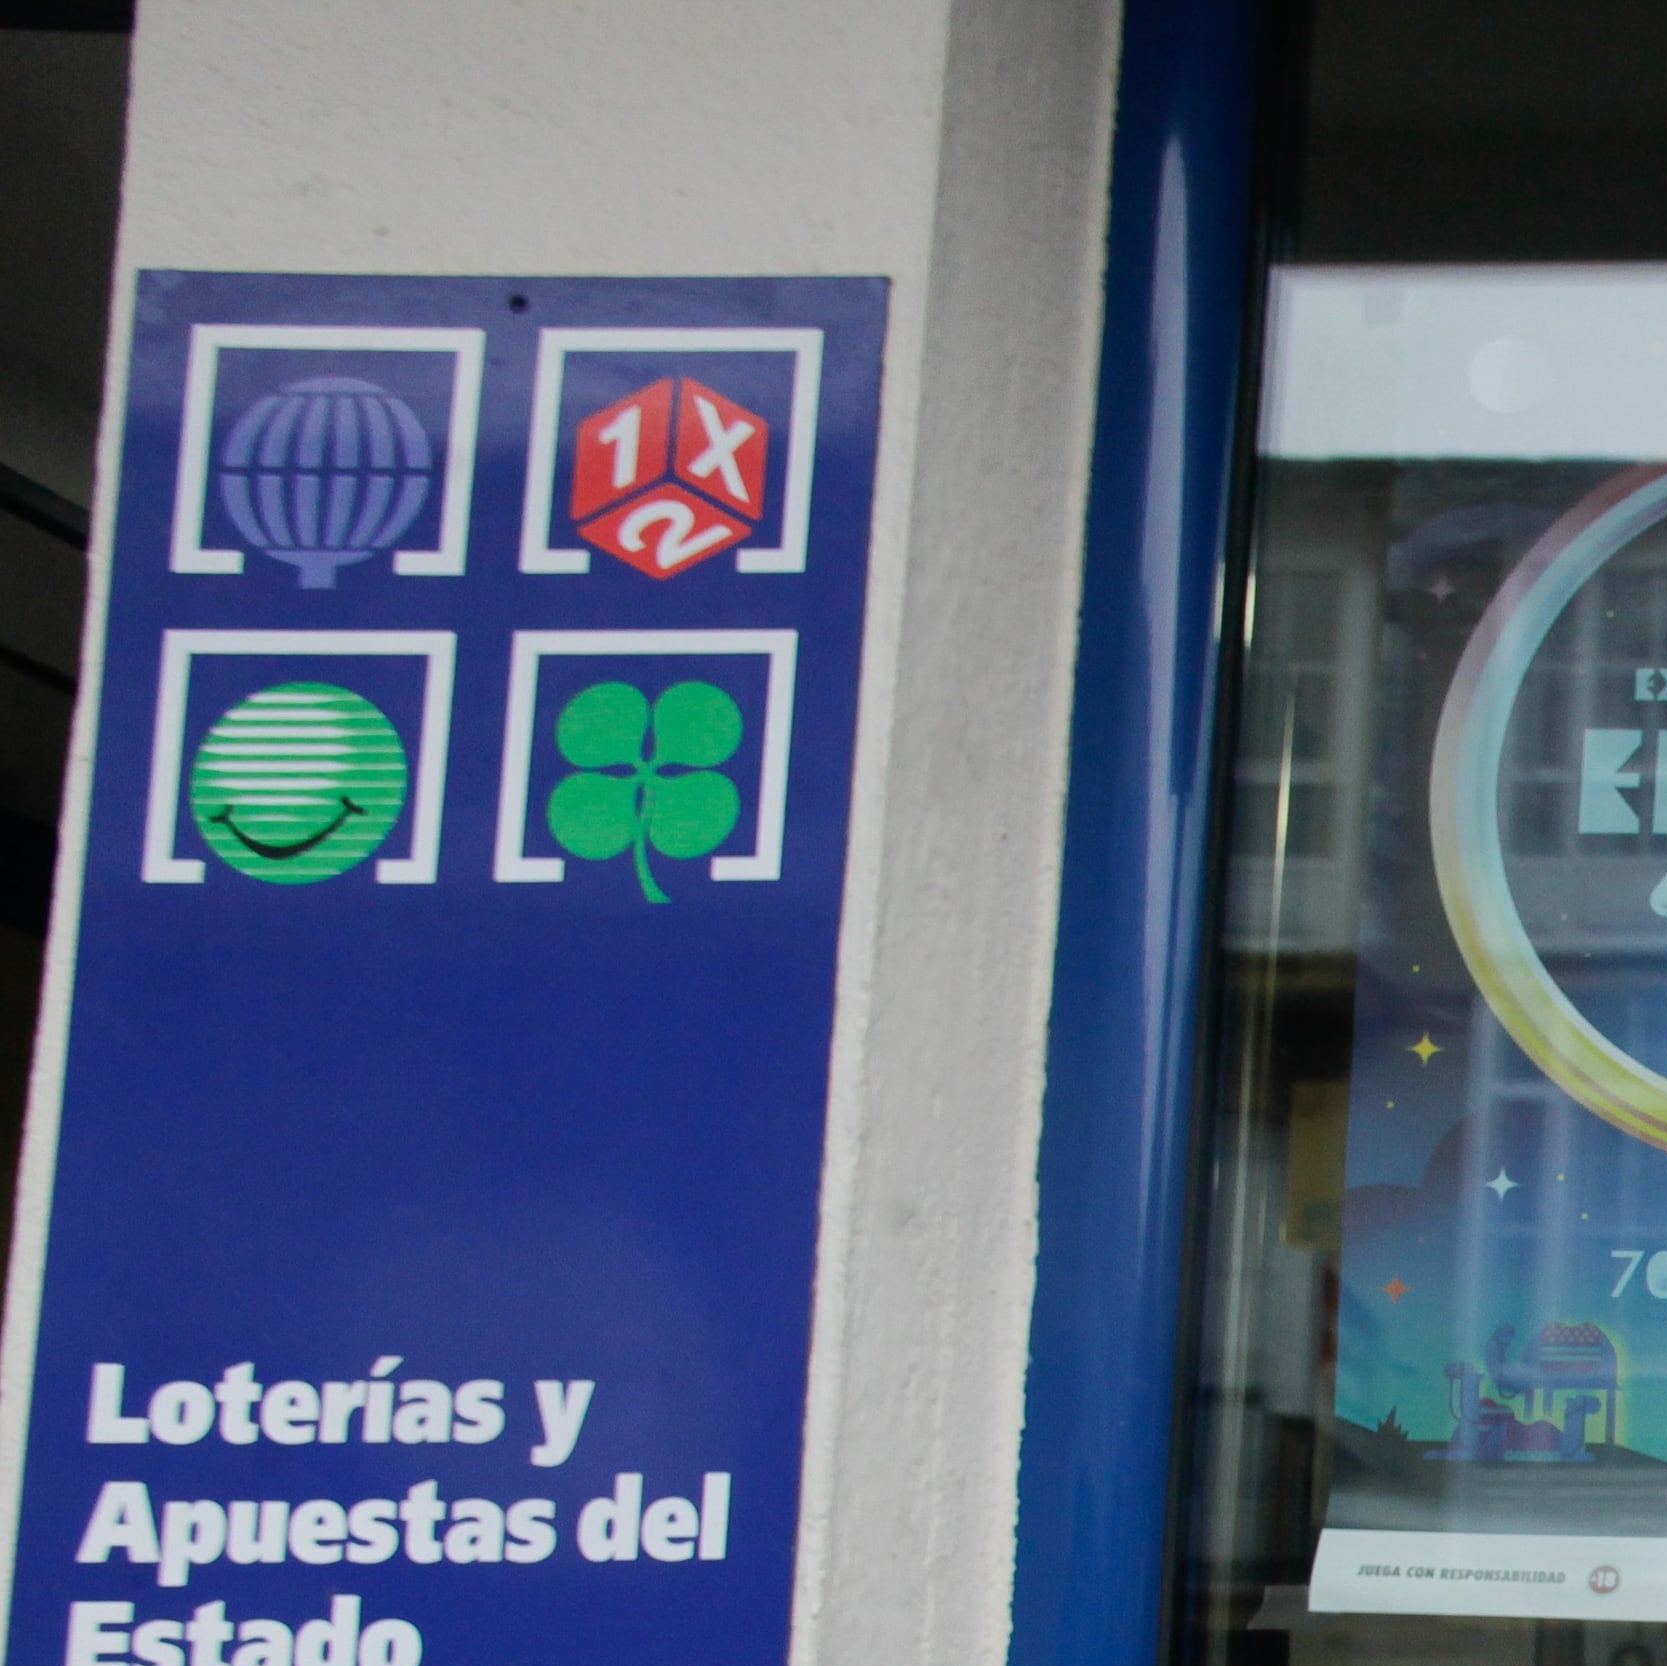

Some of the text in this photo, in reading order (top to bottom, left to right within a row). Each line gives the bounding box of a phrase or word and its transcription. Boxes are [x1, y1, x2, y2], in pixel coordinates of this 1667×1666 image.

[85, 1355, 597, 1468] Loterías y
[75, 1471, 732, 1588] Apuestas del
[1356, 1563, 1402, 1578] JUEGA
[1406, 1566, 1435, 1579] CON
[1440, 1568, 1566, 1585] RESPONSABILIDAD
